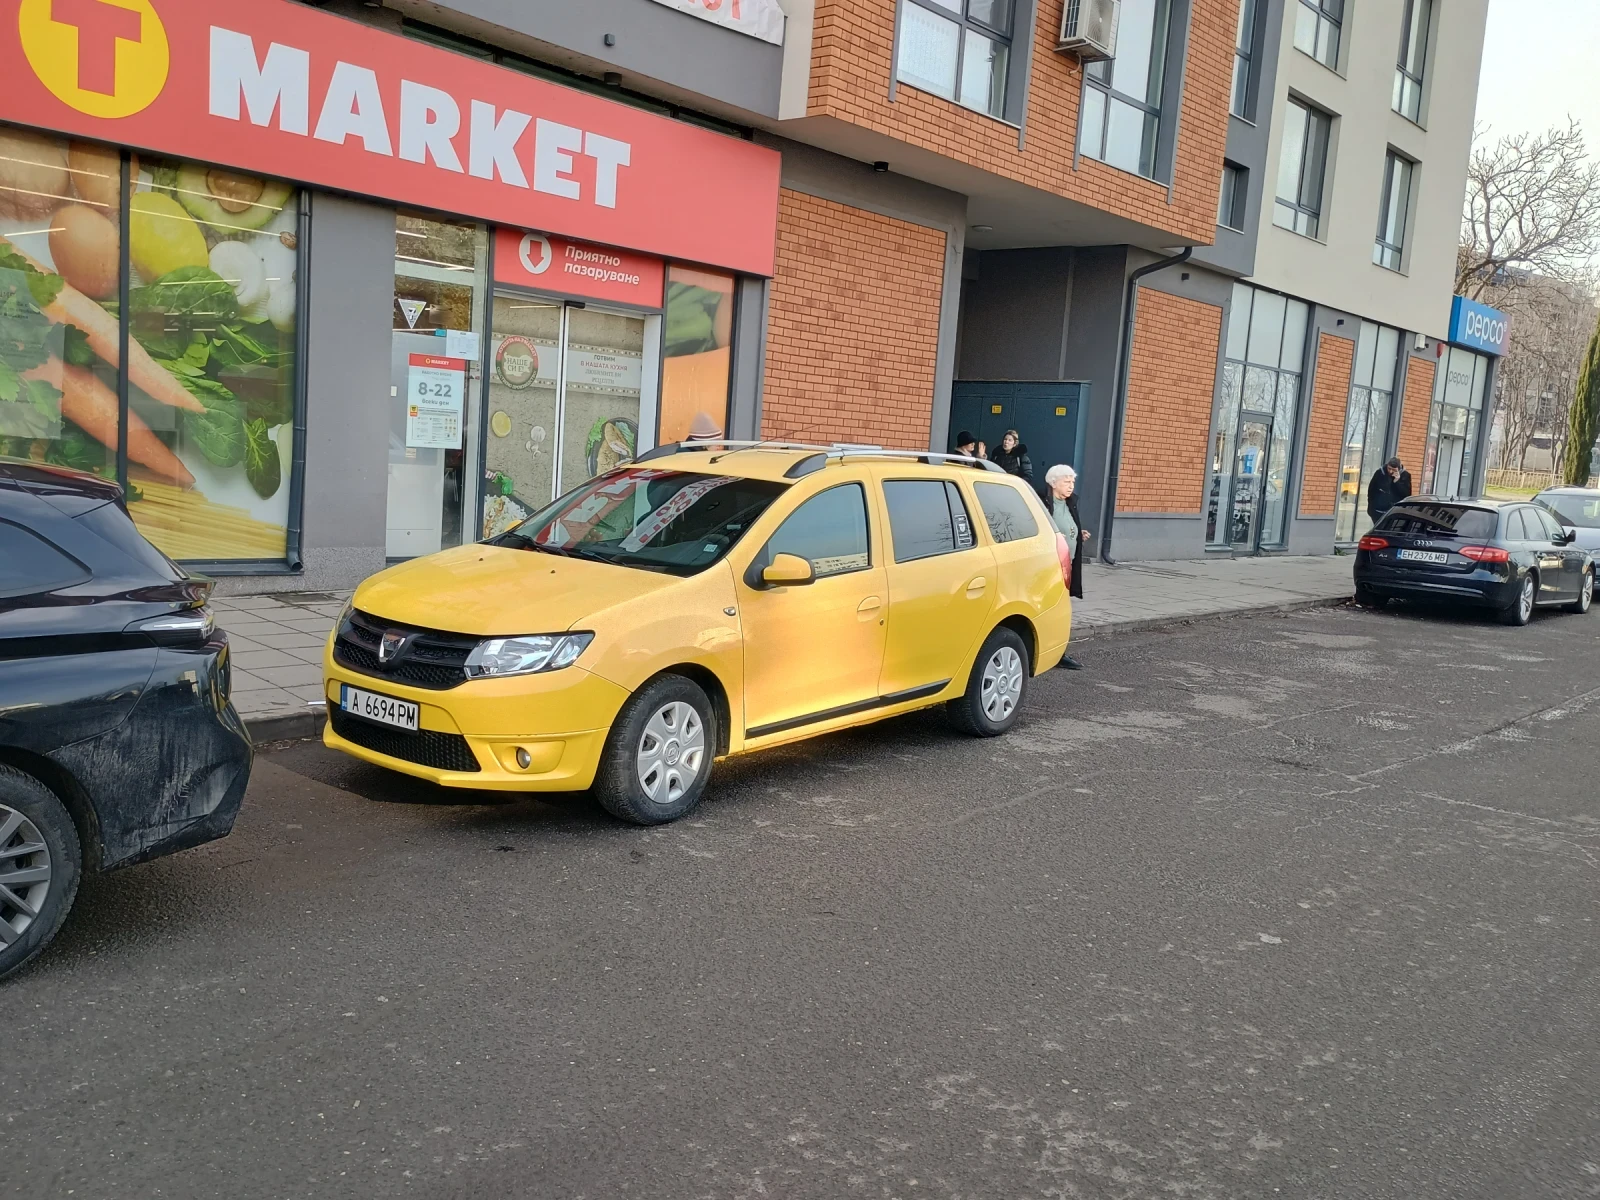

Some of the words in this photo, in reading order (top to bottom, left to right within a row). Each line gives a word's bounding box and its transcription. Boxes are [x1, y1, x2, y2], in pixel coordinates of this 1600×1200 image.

[208, 25, 631, 209] MARKET
[565, 245, 620, 267] Приятно
[564, 262, 640, 285] пазаруване
[507, 357, 528, 366] НАШЕ
[585, 361, 609, 369] НАШАТА
[594, 354, 616, 362] ГОТВИМ
[418, 382, 452, 398] 8-22
[1413, 552, 1433, 561] 2376
[352, 692, 359, 712] A
